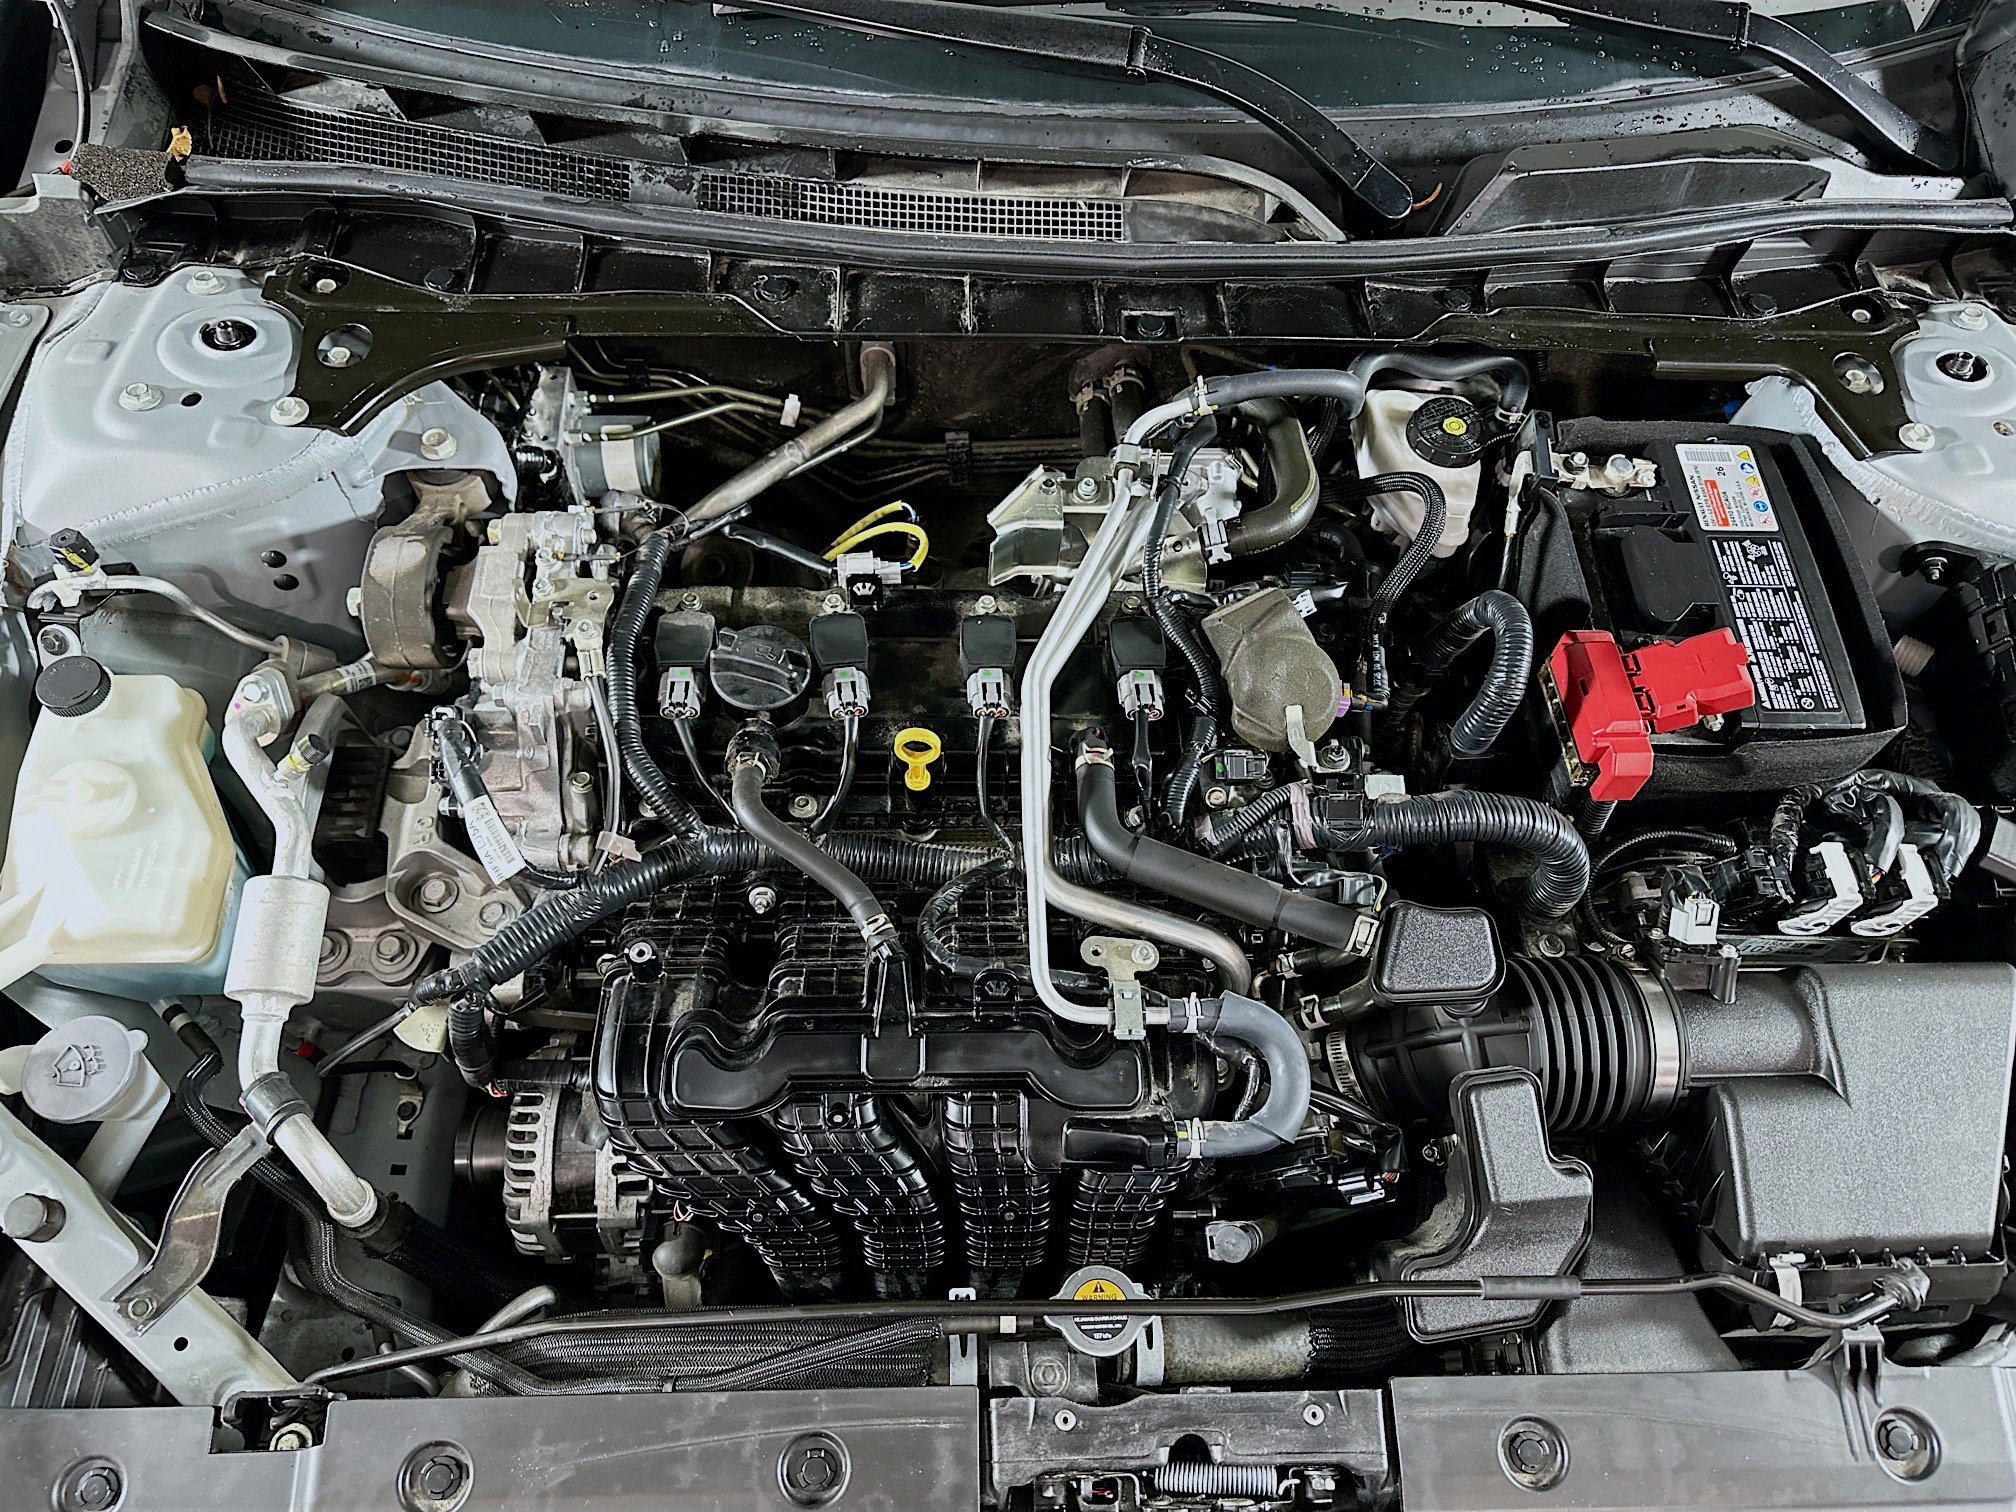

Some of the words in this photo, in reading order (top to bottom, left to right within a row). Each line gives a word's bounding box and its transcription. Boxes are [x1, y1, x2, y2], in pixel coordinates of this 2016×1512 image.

[1715, 466, 1726, 476] 26
[1689, 474, 1701, 499] NISSAN
[1698, 502, 1709, 526] RENAULT
[1728, 510, 1738, 526] 24410
